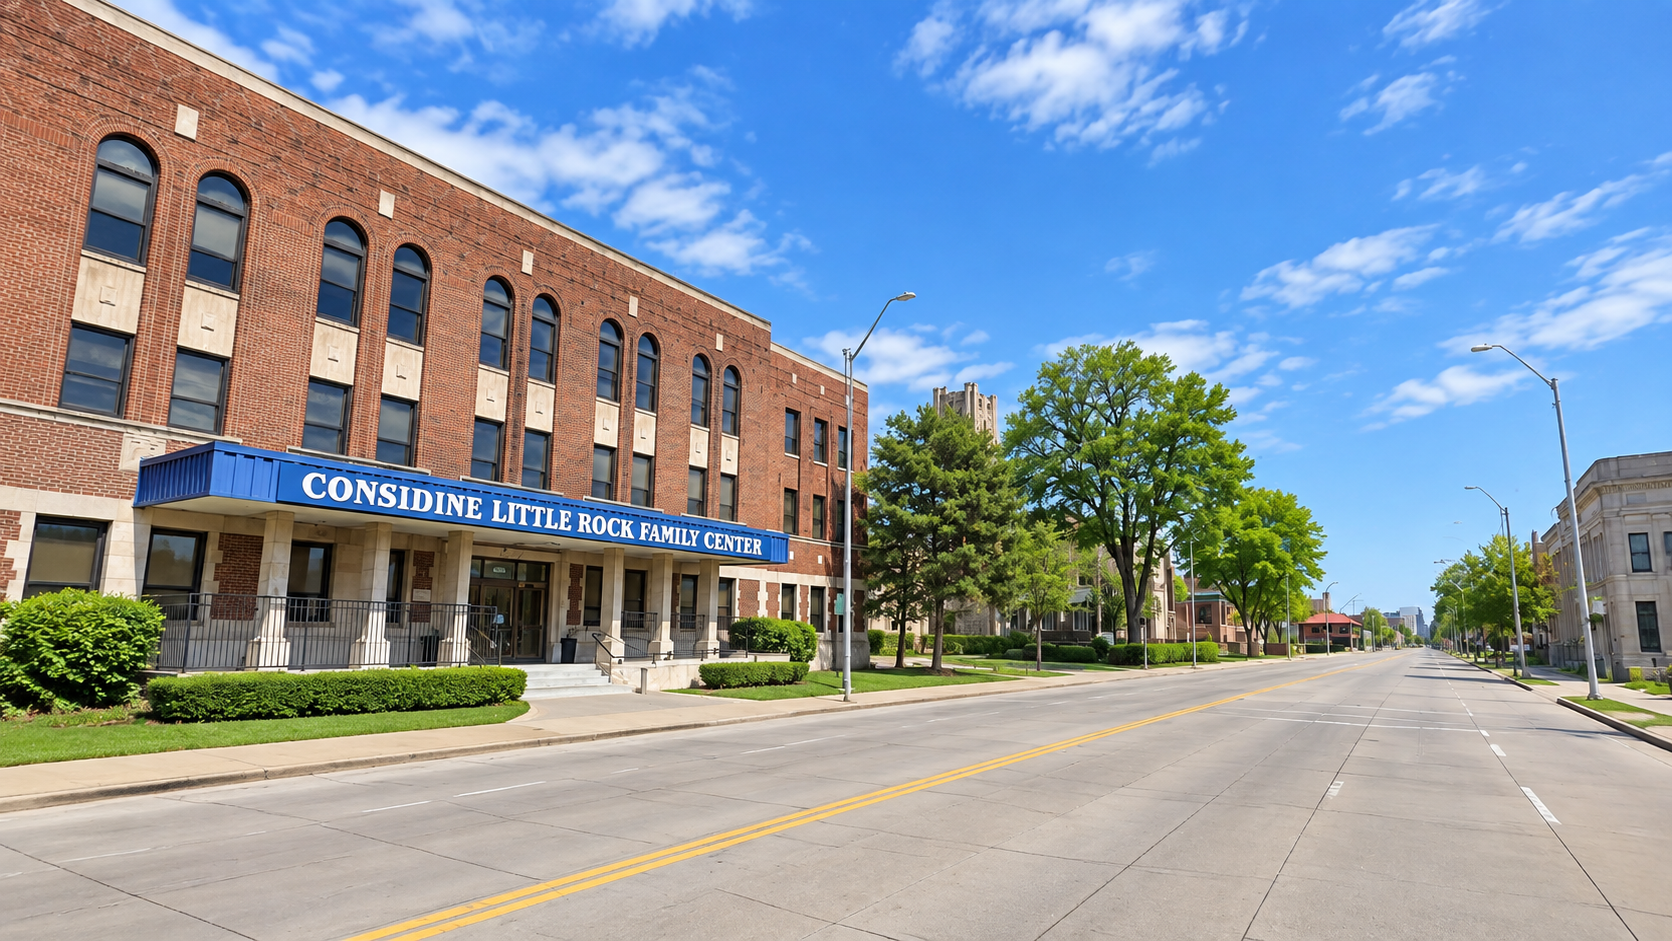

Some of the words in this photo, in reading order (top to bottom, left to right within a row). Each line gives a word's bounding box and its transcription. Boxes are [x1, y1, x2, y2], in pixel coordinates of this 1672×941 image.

[302, 472, 483, 520] CONSIDINE
[491, 499, 572, 532] LITTLE
[577, 512, 635, 539] ROCK
[638, 522, 701, 547] FAMILY
[703, 531, 763, 556] CENTER
